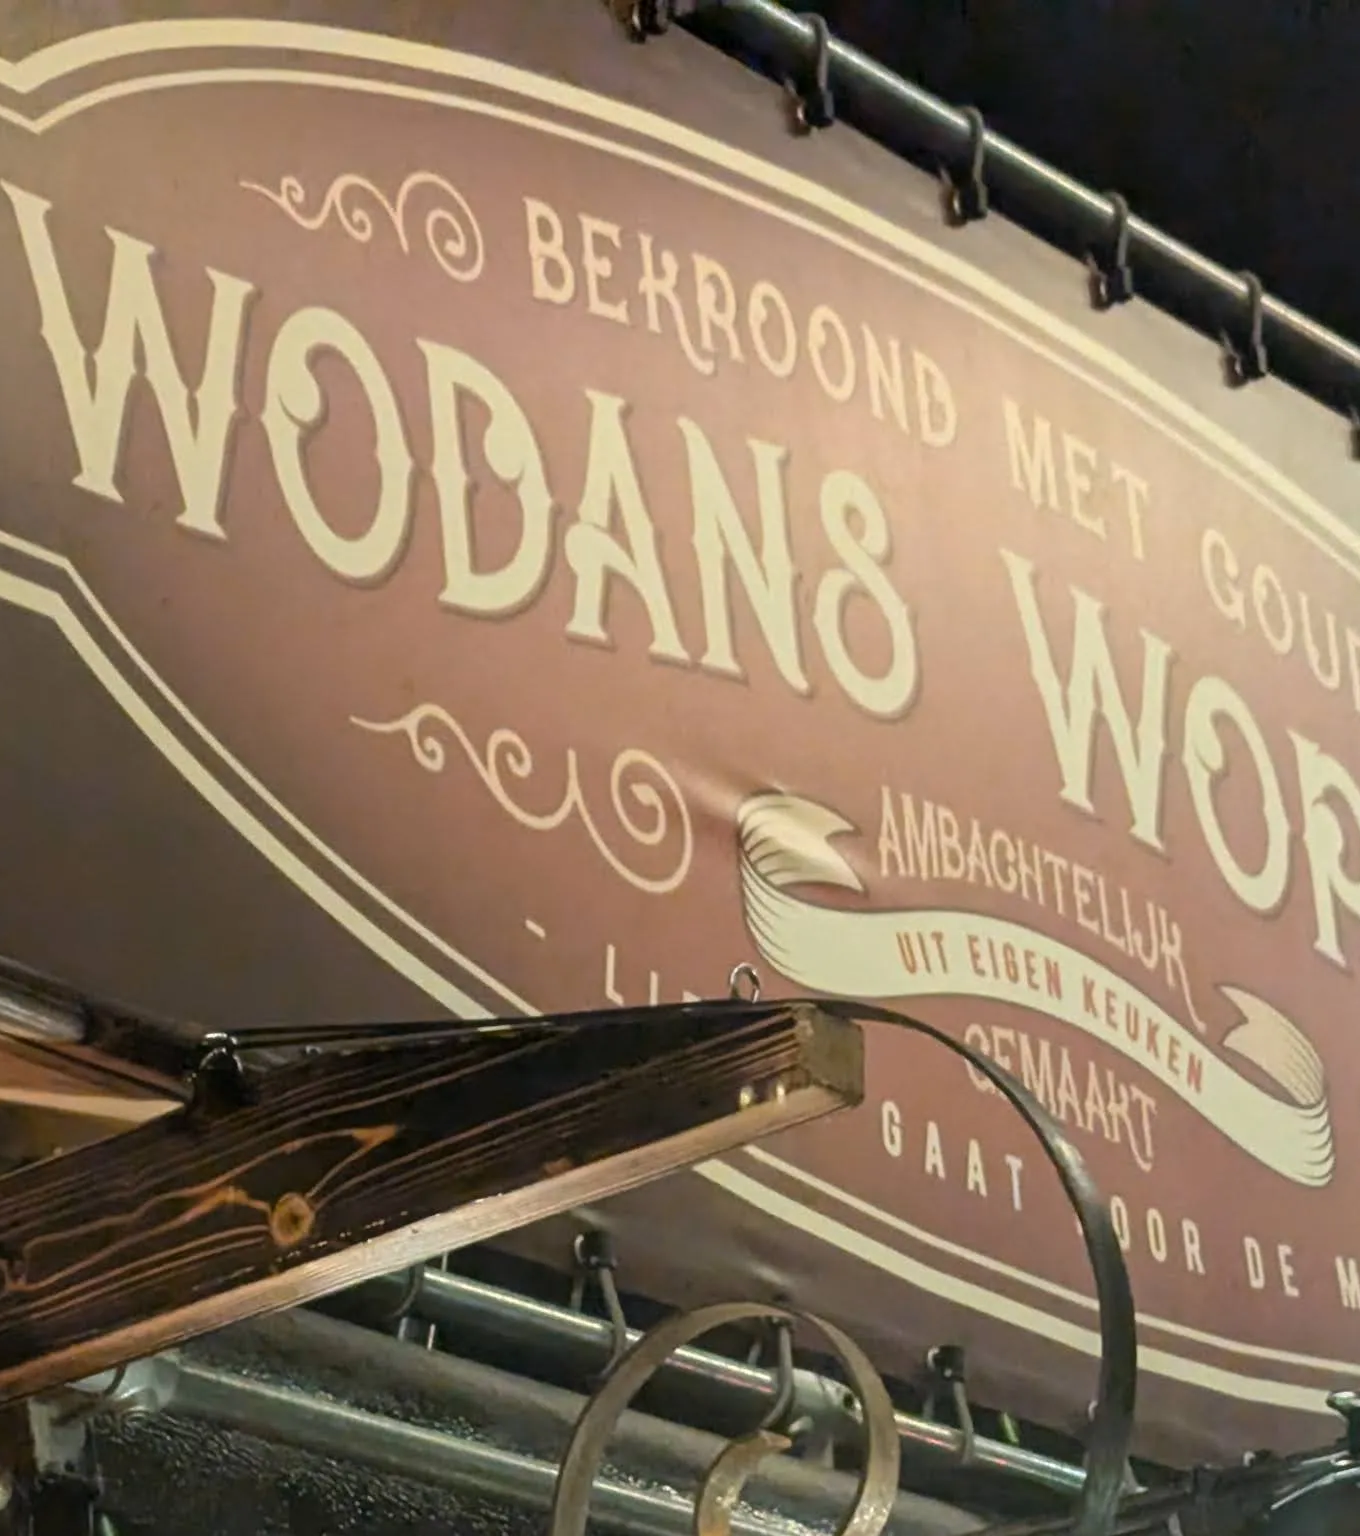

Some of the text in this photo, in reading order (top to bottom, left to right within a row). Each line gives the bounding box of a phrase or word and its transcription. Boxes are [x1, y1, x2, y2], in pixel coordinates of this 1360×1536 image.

[1, 180, 918, 719] WODANS
[525, 197, 958, 446] BEKROOND
[1001, 384, 1151, 560] MET
[878, 785, 1207, 1034] AMBACHTELIJK
[896, 931, 1204, 1094] UIT EIGEN KEUKEN
[881, 1100, 1023, 1211] GAAT
[1078, 1194, 1206, 1276] OOR
[1244, 1236, 1300, 1297] DE
